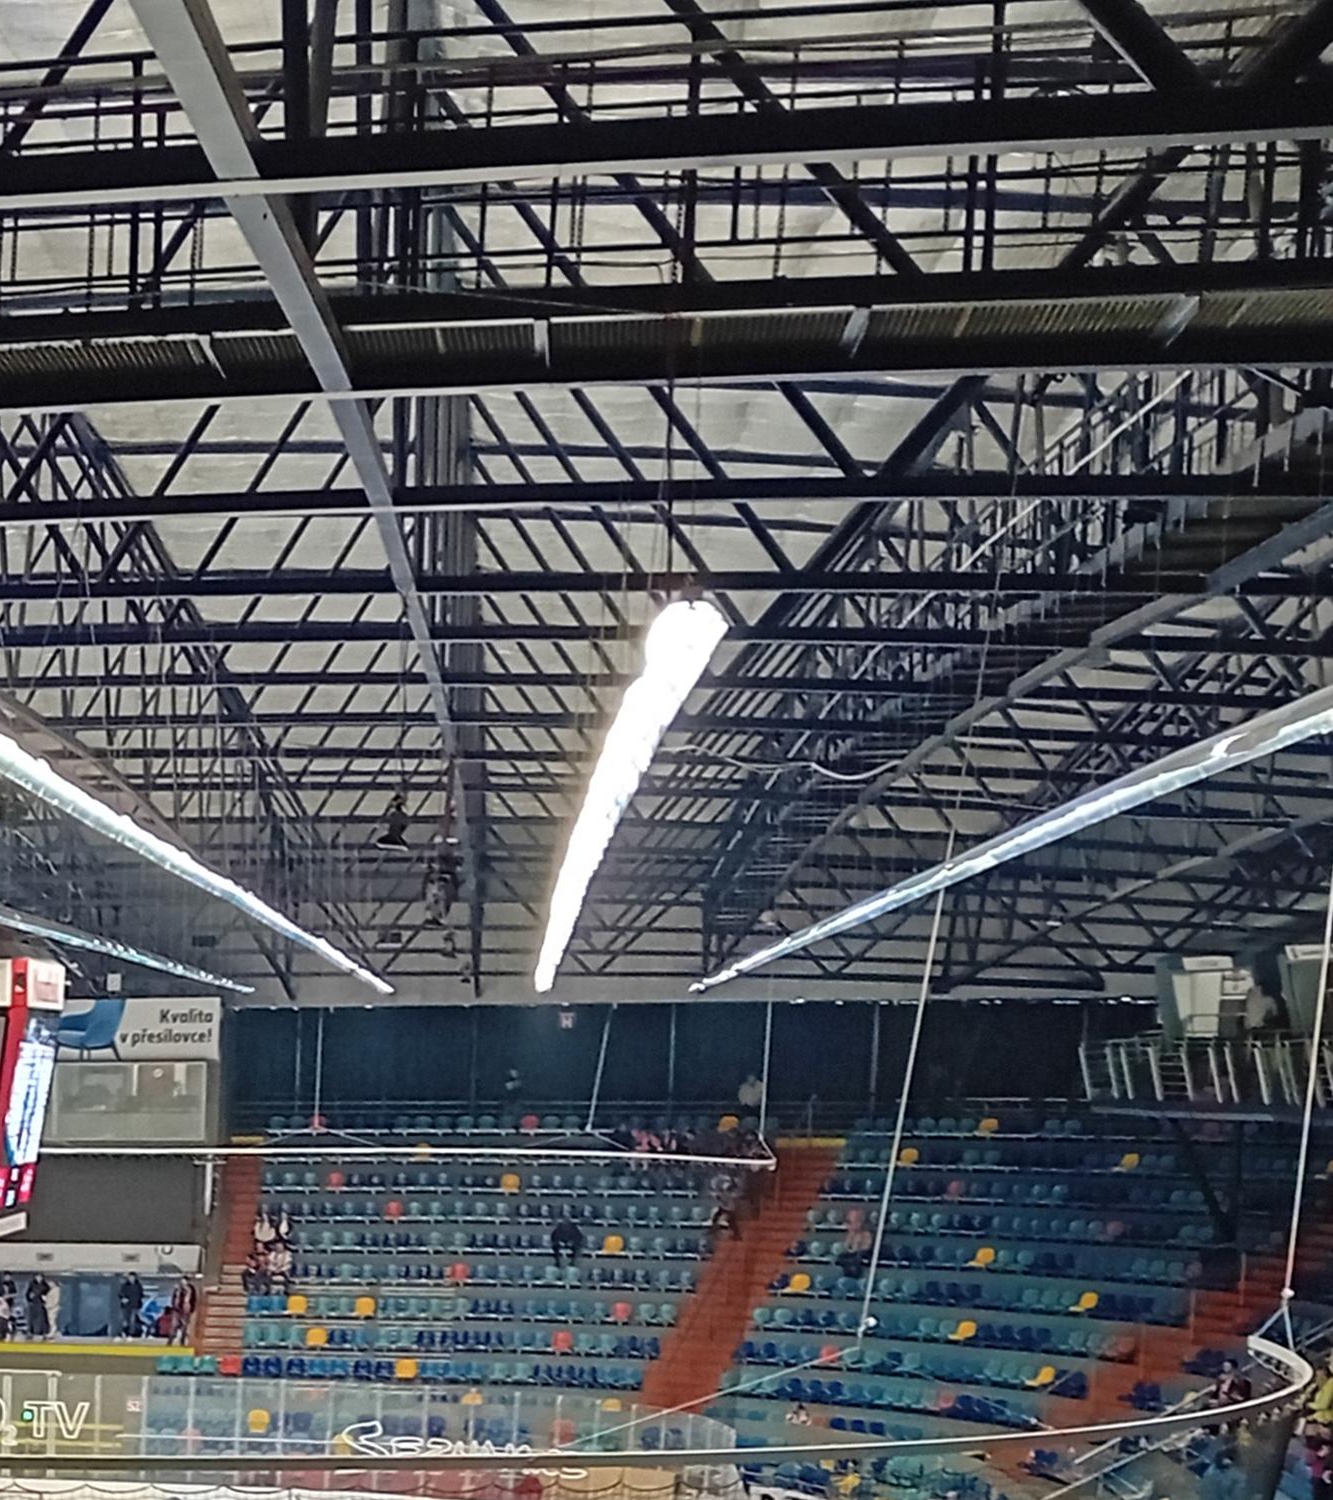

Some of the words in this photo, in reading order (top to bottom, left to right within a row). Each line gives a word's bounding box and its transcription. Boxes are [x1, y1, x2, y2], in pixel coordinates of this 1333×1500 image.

[159, 1008, 213, 1024] Kvalita
[119, 1032, 129, 1044] v
[22, 1400, 91, 1440] TV
